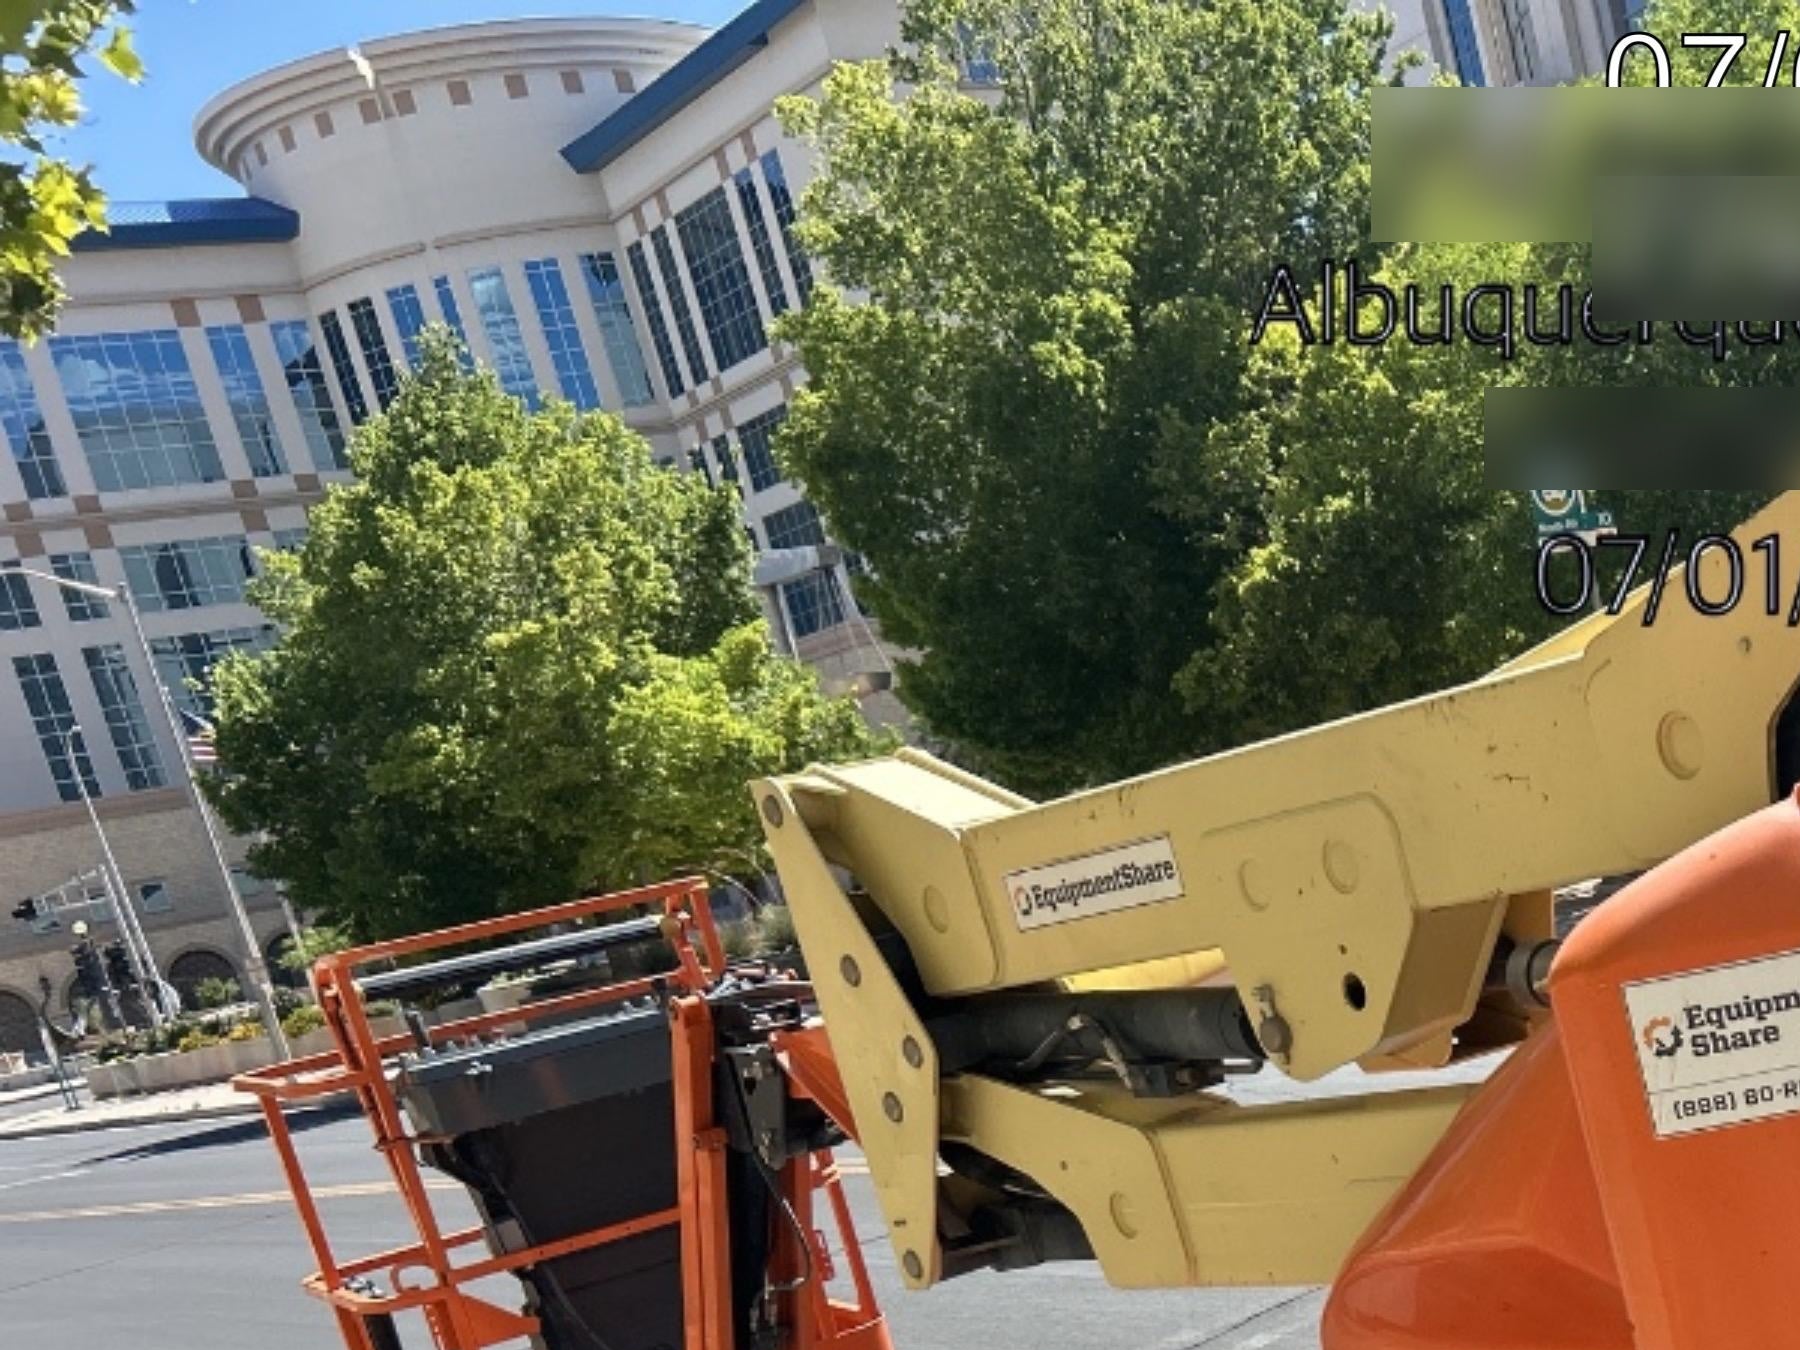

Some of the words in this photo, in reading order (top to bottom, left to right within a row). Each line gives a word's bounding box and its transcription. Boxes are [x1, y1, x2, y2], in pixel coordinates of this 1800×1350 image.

[1031, 859, 1176, 912] EquipmentShare
[1691, 1025, 1781, 1057] Share
[1673, 1091, 1738, 1120] (888)
